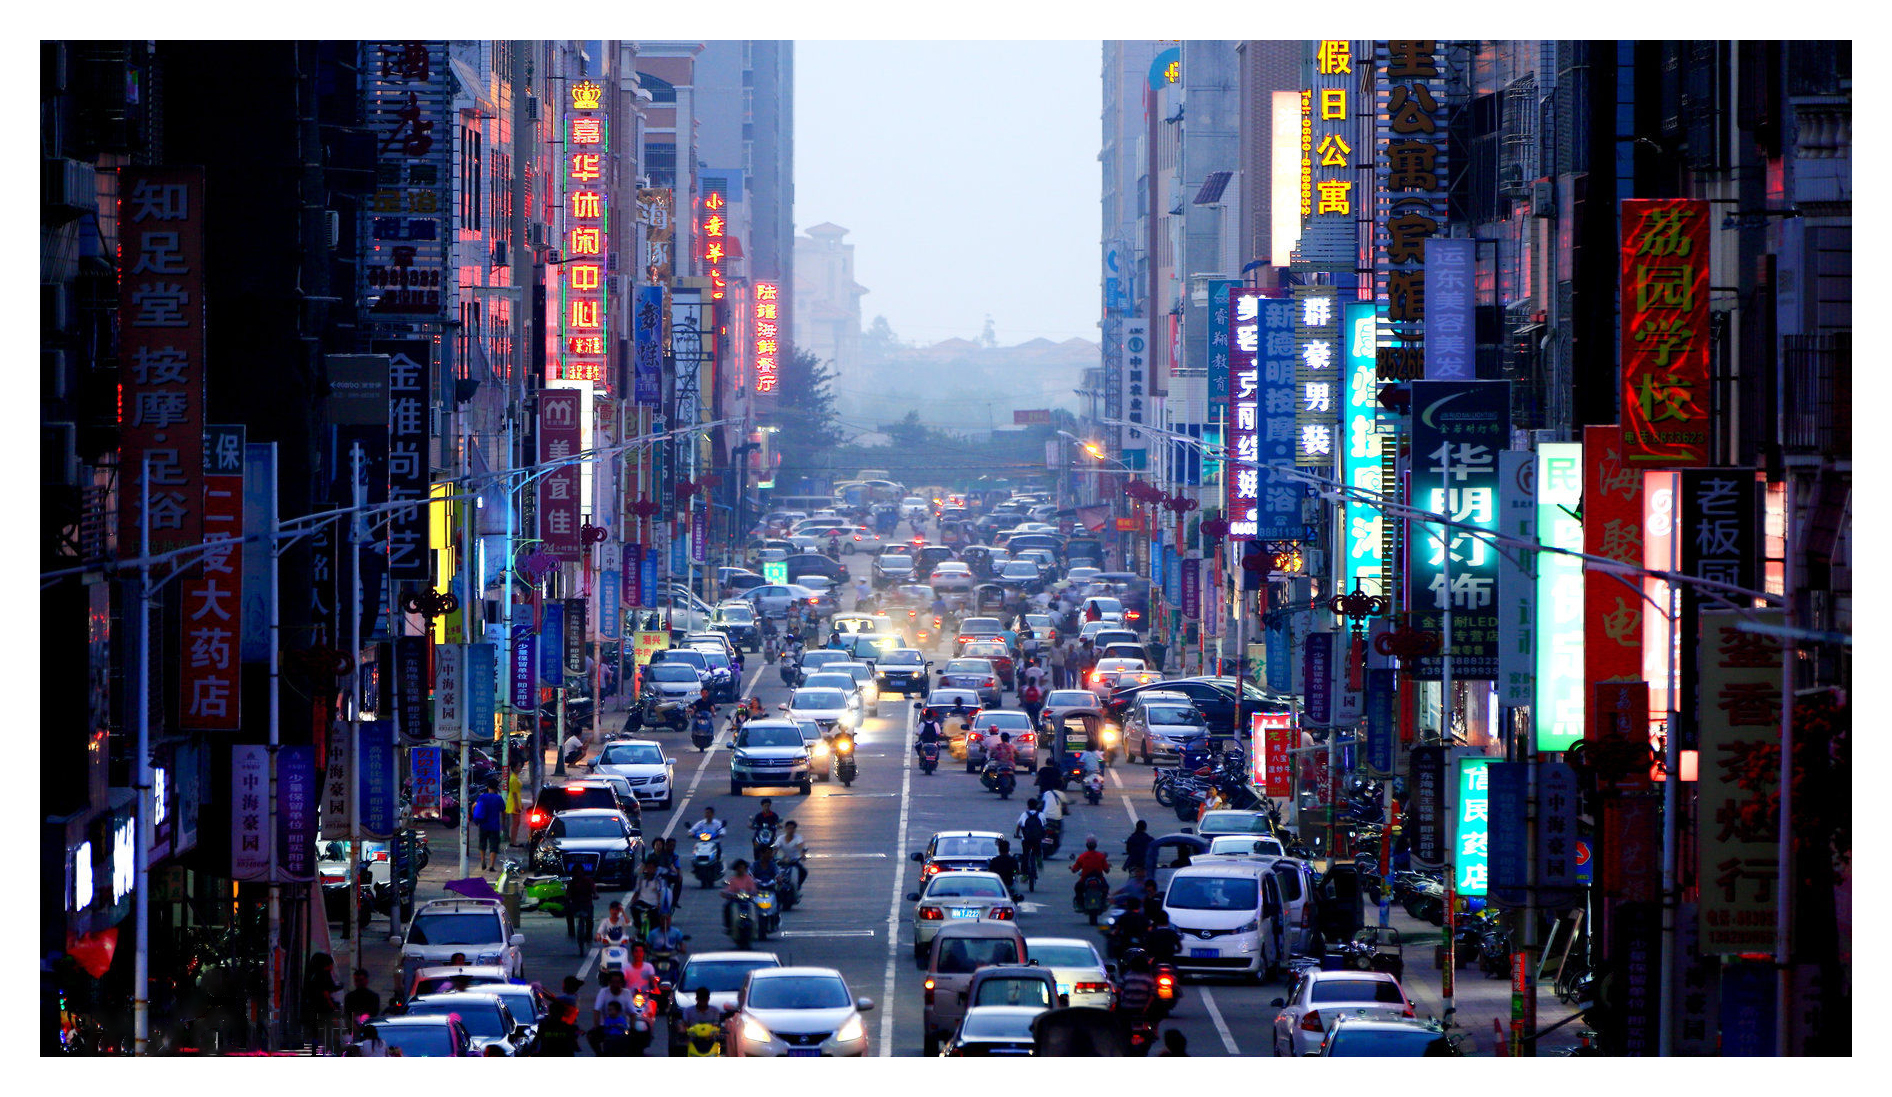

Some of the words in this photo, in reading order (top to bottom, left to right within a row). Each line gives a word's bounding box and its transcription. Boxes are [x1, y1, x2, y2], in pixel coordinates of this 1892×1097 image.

[1317, 41, 1351, 215] 假日公寓
[131, 178, 189, 329] 知足堂
[572, 118, 601, 328] 嘉华休闲中心
[1302, 300, 1333, 459] 群豪男装
[1434, 247, 1468, 379] 运东美容美发
[1635, 207, 1695, 423] 荔园学校
[1428, 442, 1494, 611] 华明灯饰
[1599, 447, 1642, 682] 海聚电
[1696, 477, 1740, 608] 老板厨
[243, 773, 259, 852] 中海豪园
[1461, 766, 1488, 890] 信民药店
